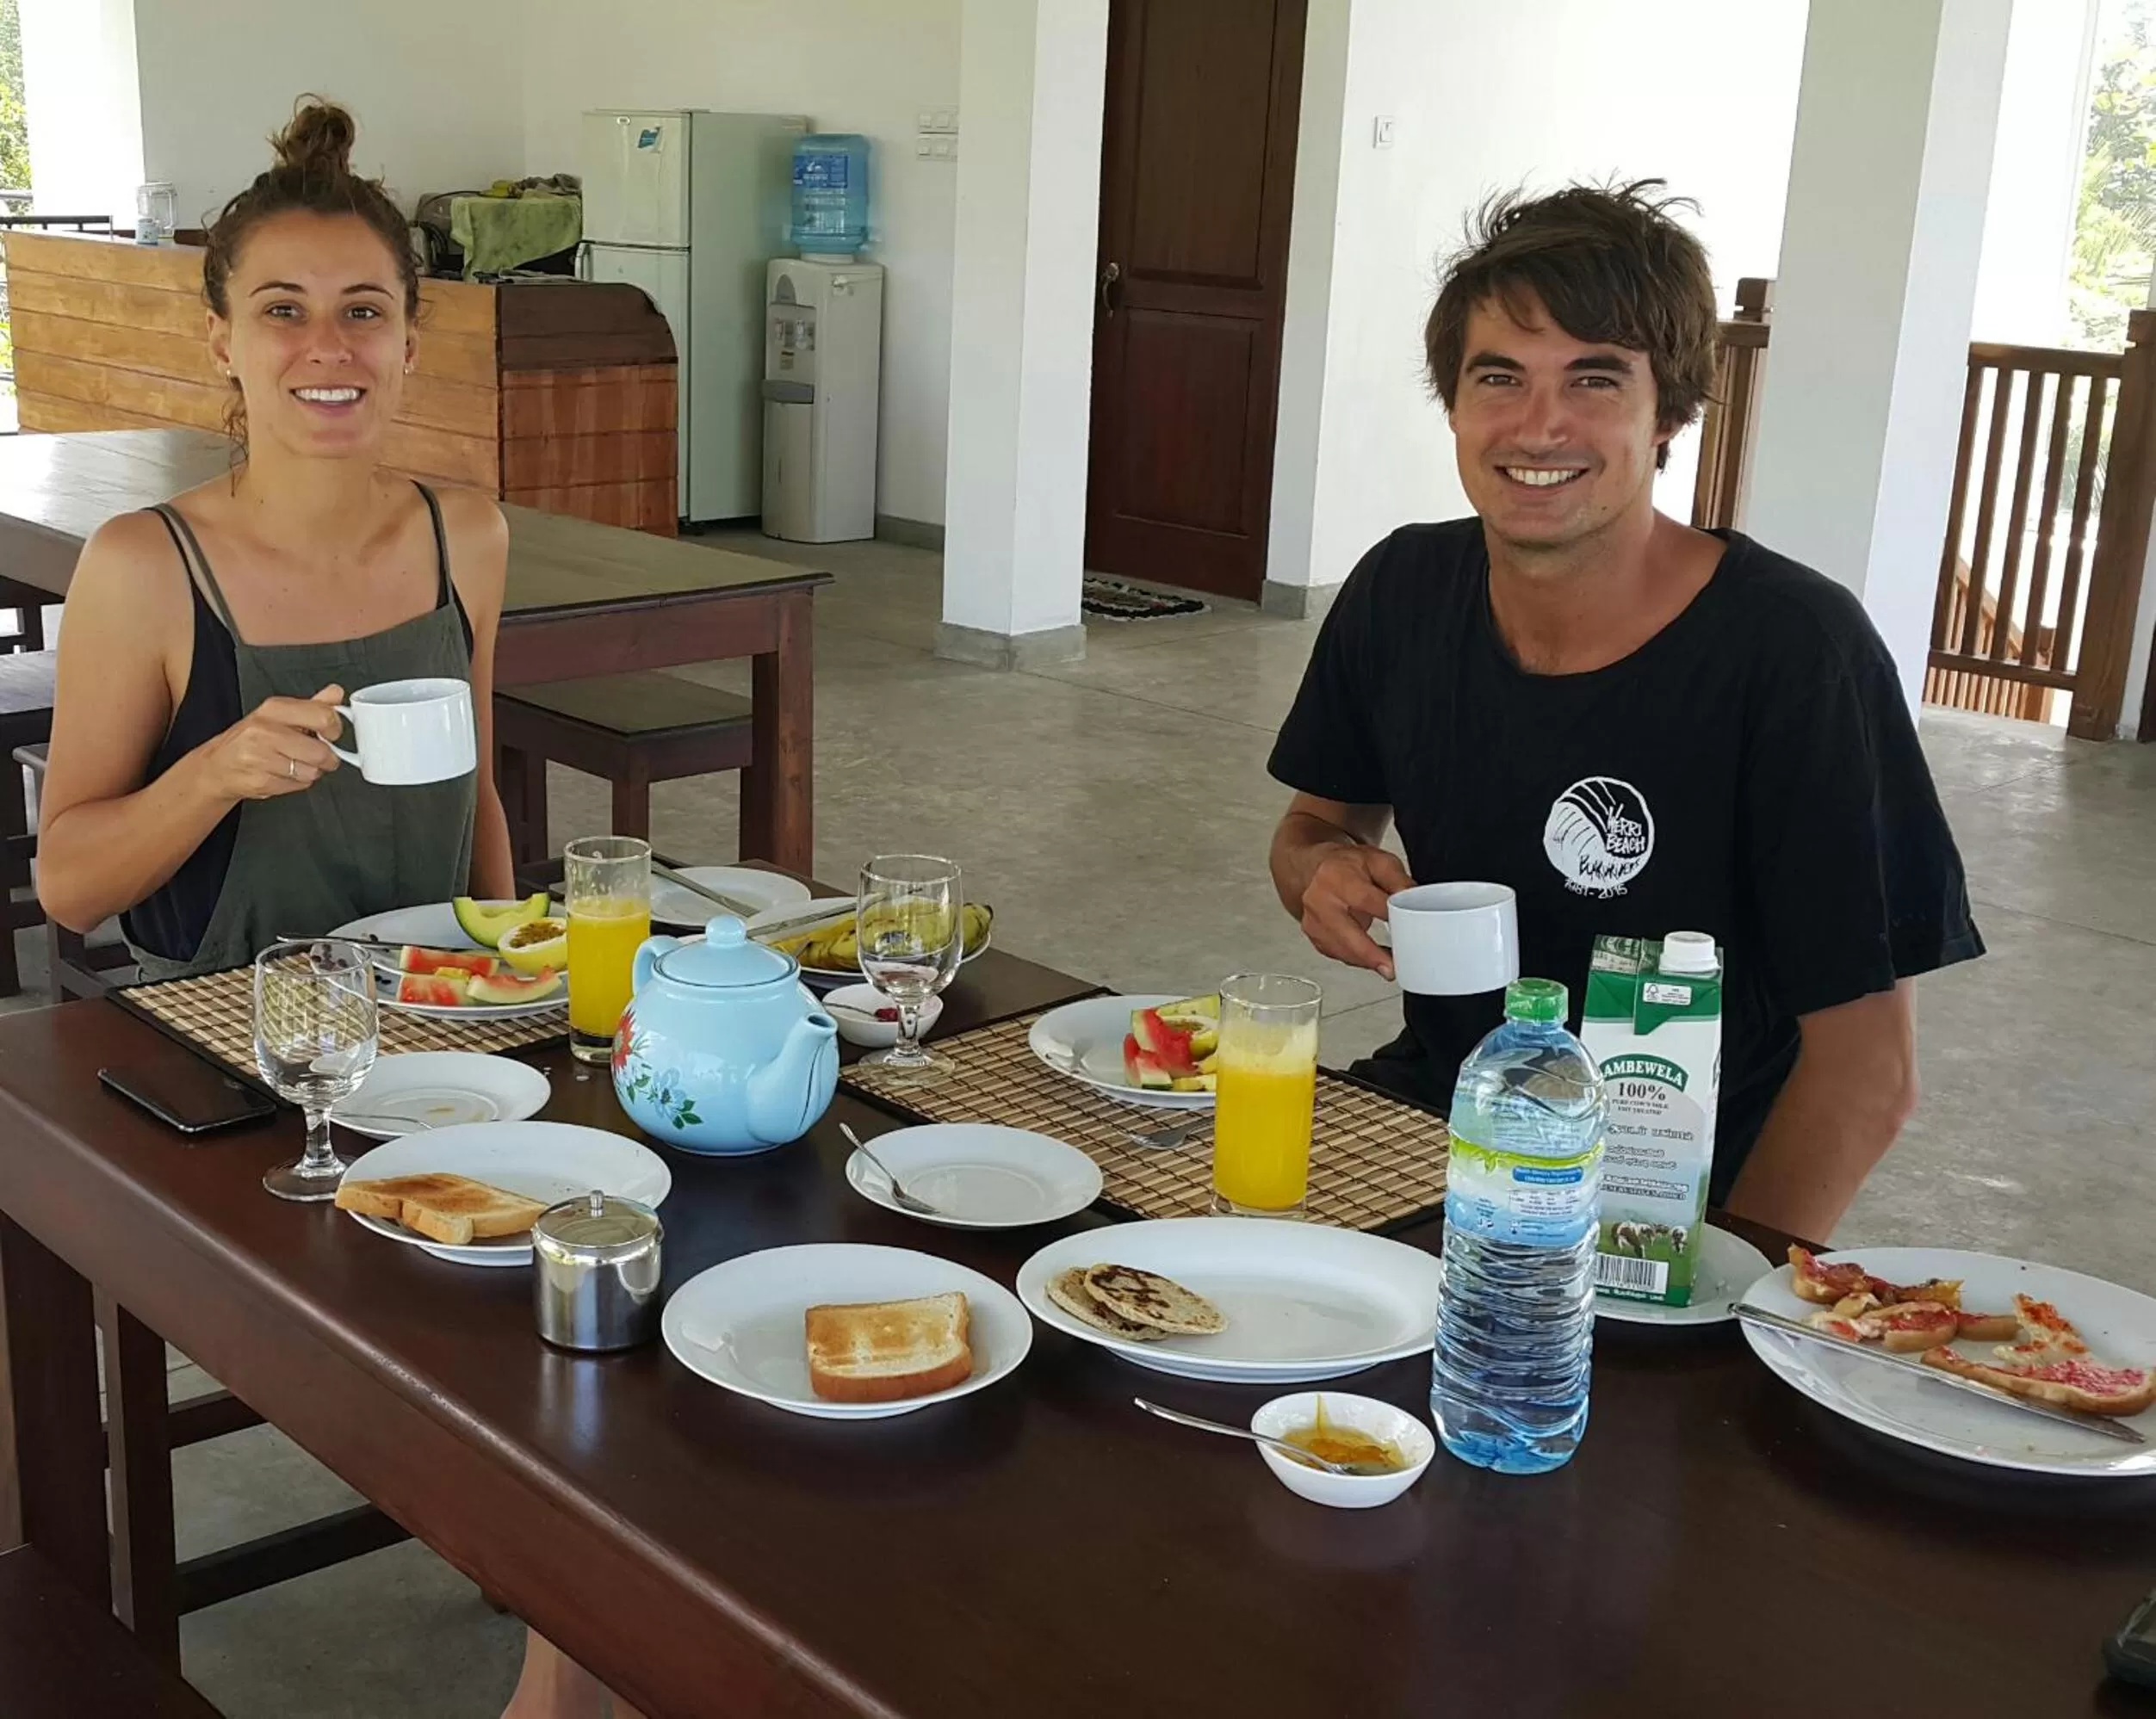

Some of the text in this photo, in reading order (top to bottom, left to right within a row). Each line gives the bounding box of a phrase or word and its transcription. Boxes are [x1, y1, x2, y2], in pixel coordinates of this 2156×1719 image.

[1606, 833, 1645, 854] BEACH
[1604, 1060, 1682, 1085] AMBEWELA
[1619, 1082, 1666, 1100] 100%
